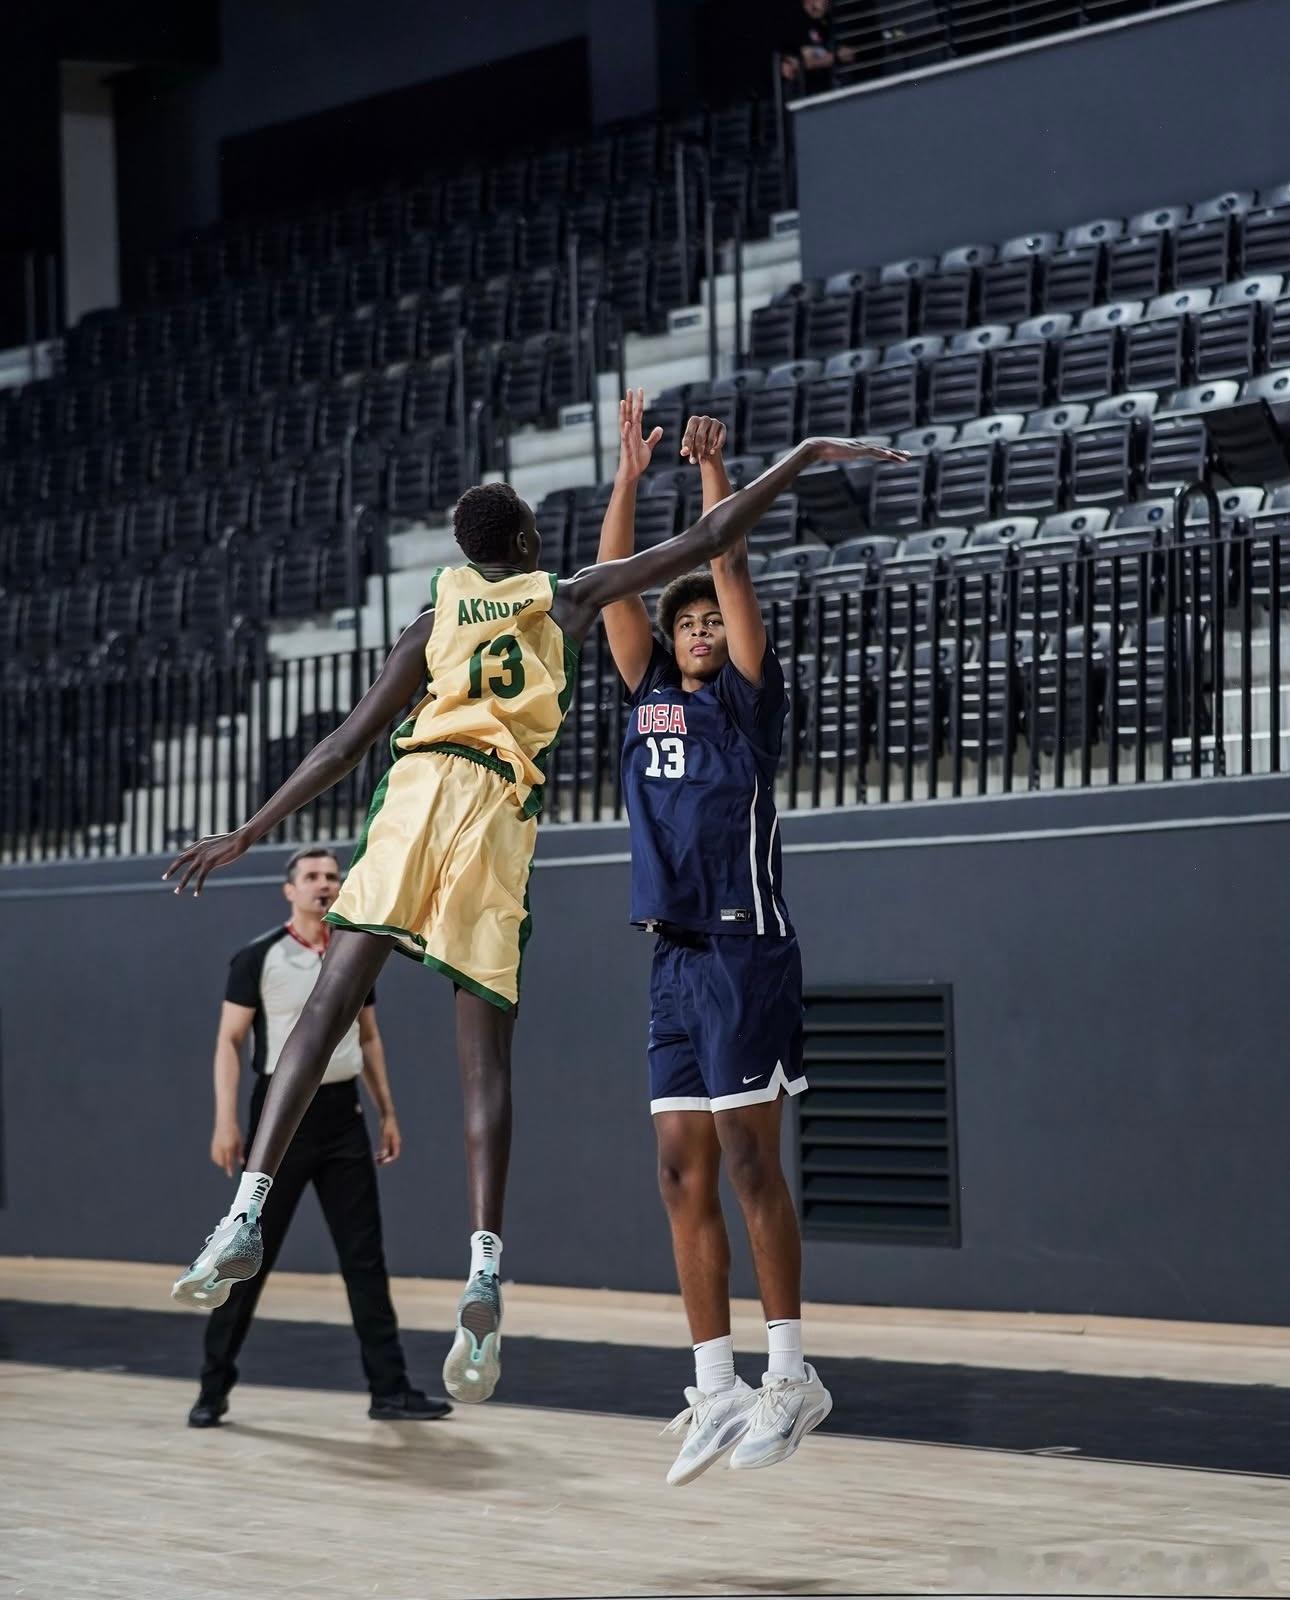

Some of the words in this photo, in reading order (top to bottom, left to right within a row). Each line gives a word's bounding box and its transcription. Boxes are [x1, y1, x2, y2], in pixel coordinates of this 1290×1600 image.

[468, 634, 525, 699] 13
[637, 703, 688, 735] USA
[645, 737, 686, 779] 13
